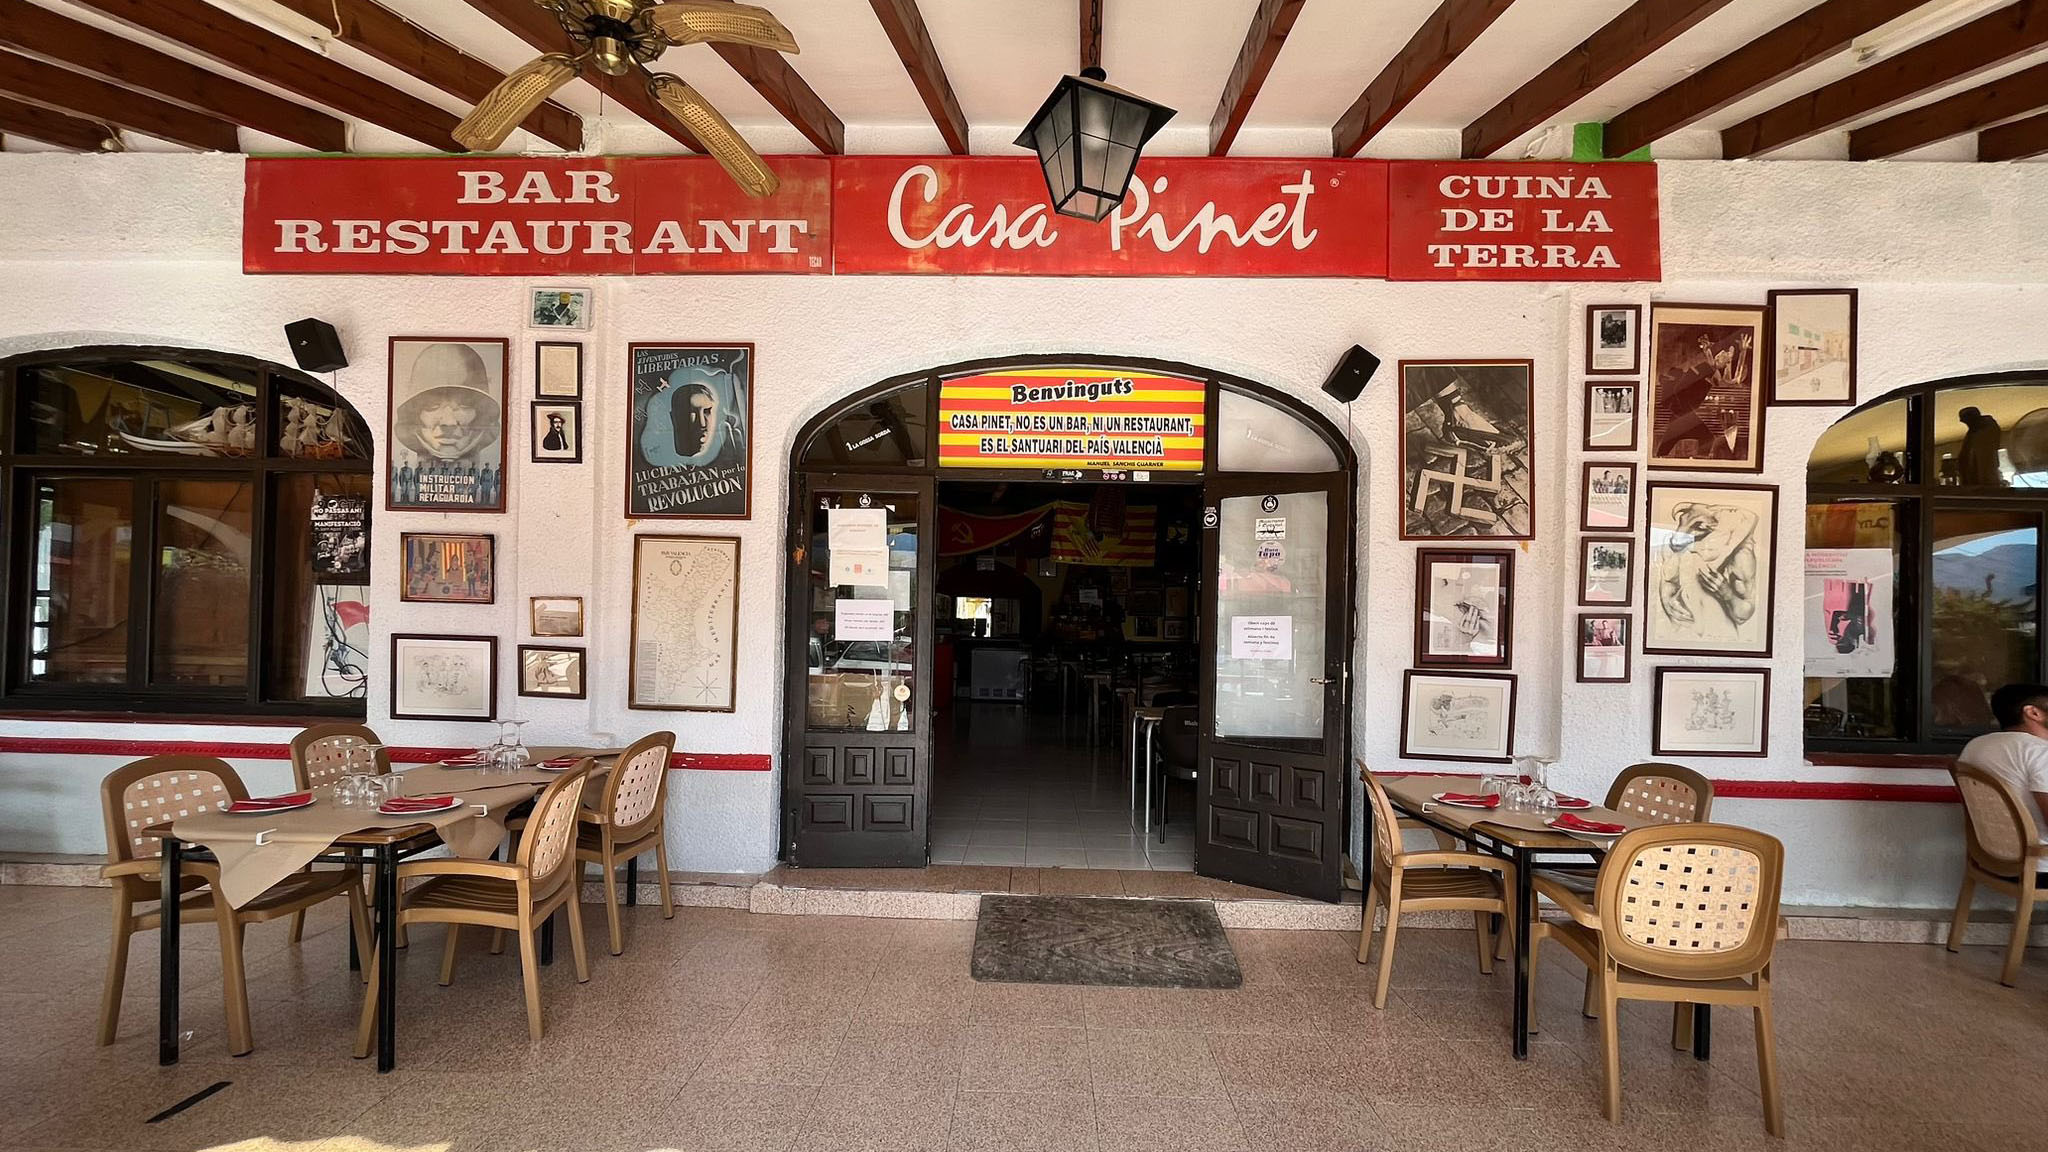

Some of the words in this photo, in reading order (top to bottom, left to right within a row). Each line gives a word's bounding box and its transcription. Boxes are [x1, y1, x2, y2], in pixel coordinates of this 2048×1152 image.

[456, 170, 620, 204] BAR
[1439, 175, 1612, 199] CUINA
[887, 164, 1059, 250] Casa
[1110, 168, 1319, 255] Pinet
[1440, 208, 1514, 232] DE
[1541, 209, 1614, 233] LA
[273, 219, 808, 254] RESTAURANT
[1428, 244, 1621, 269] TERRA
[637, 350, 649, 358] LAS
[1012, 378, 1133, 404] Benvinguts
[951, 414, 979, 429] CASA
[981, 414, 1013, 433] PINET,
[1015, 415, 1031, 429] NO
[1033, 416, 1046, 430] ES
[1049, 416, 1063, 430] UN
[1066, 416, 1090, 434] BAR,
[1092, 417, 1103, 431] NI
[1106, 417, 1121, 431] UN
[1123, 417, 1193, 435] RESTAURANT,
[981, 438, 994, 452] ES
[996, 438, 1009, 452] EL
[1011, 438, 1063, 453] SANTUARI
[1065, 439, 1085, 454] DEL
[1087, 435, 1110, 455] PAÍS
[1112, 436, 1163, 455] VALENCIÀ
[419, 475, 475, 485] INSTRUCCION
[635, 462, 688, 483] LUCHAN
[638, 466, 720, 497] TRABAJAN
[721, 466, 736, 479] por
[419, 484, 455, 494] MILITAR
[419, 493, 474, 504] RETAGUARDIA
[648, 475, 743, 513] REVOLUCION
